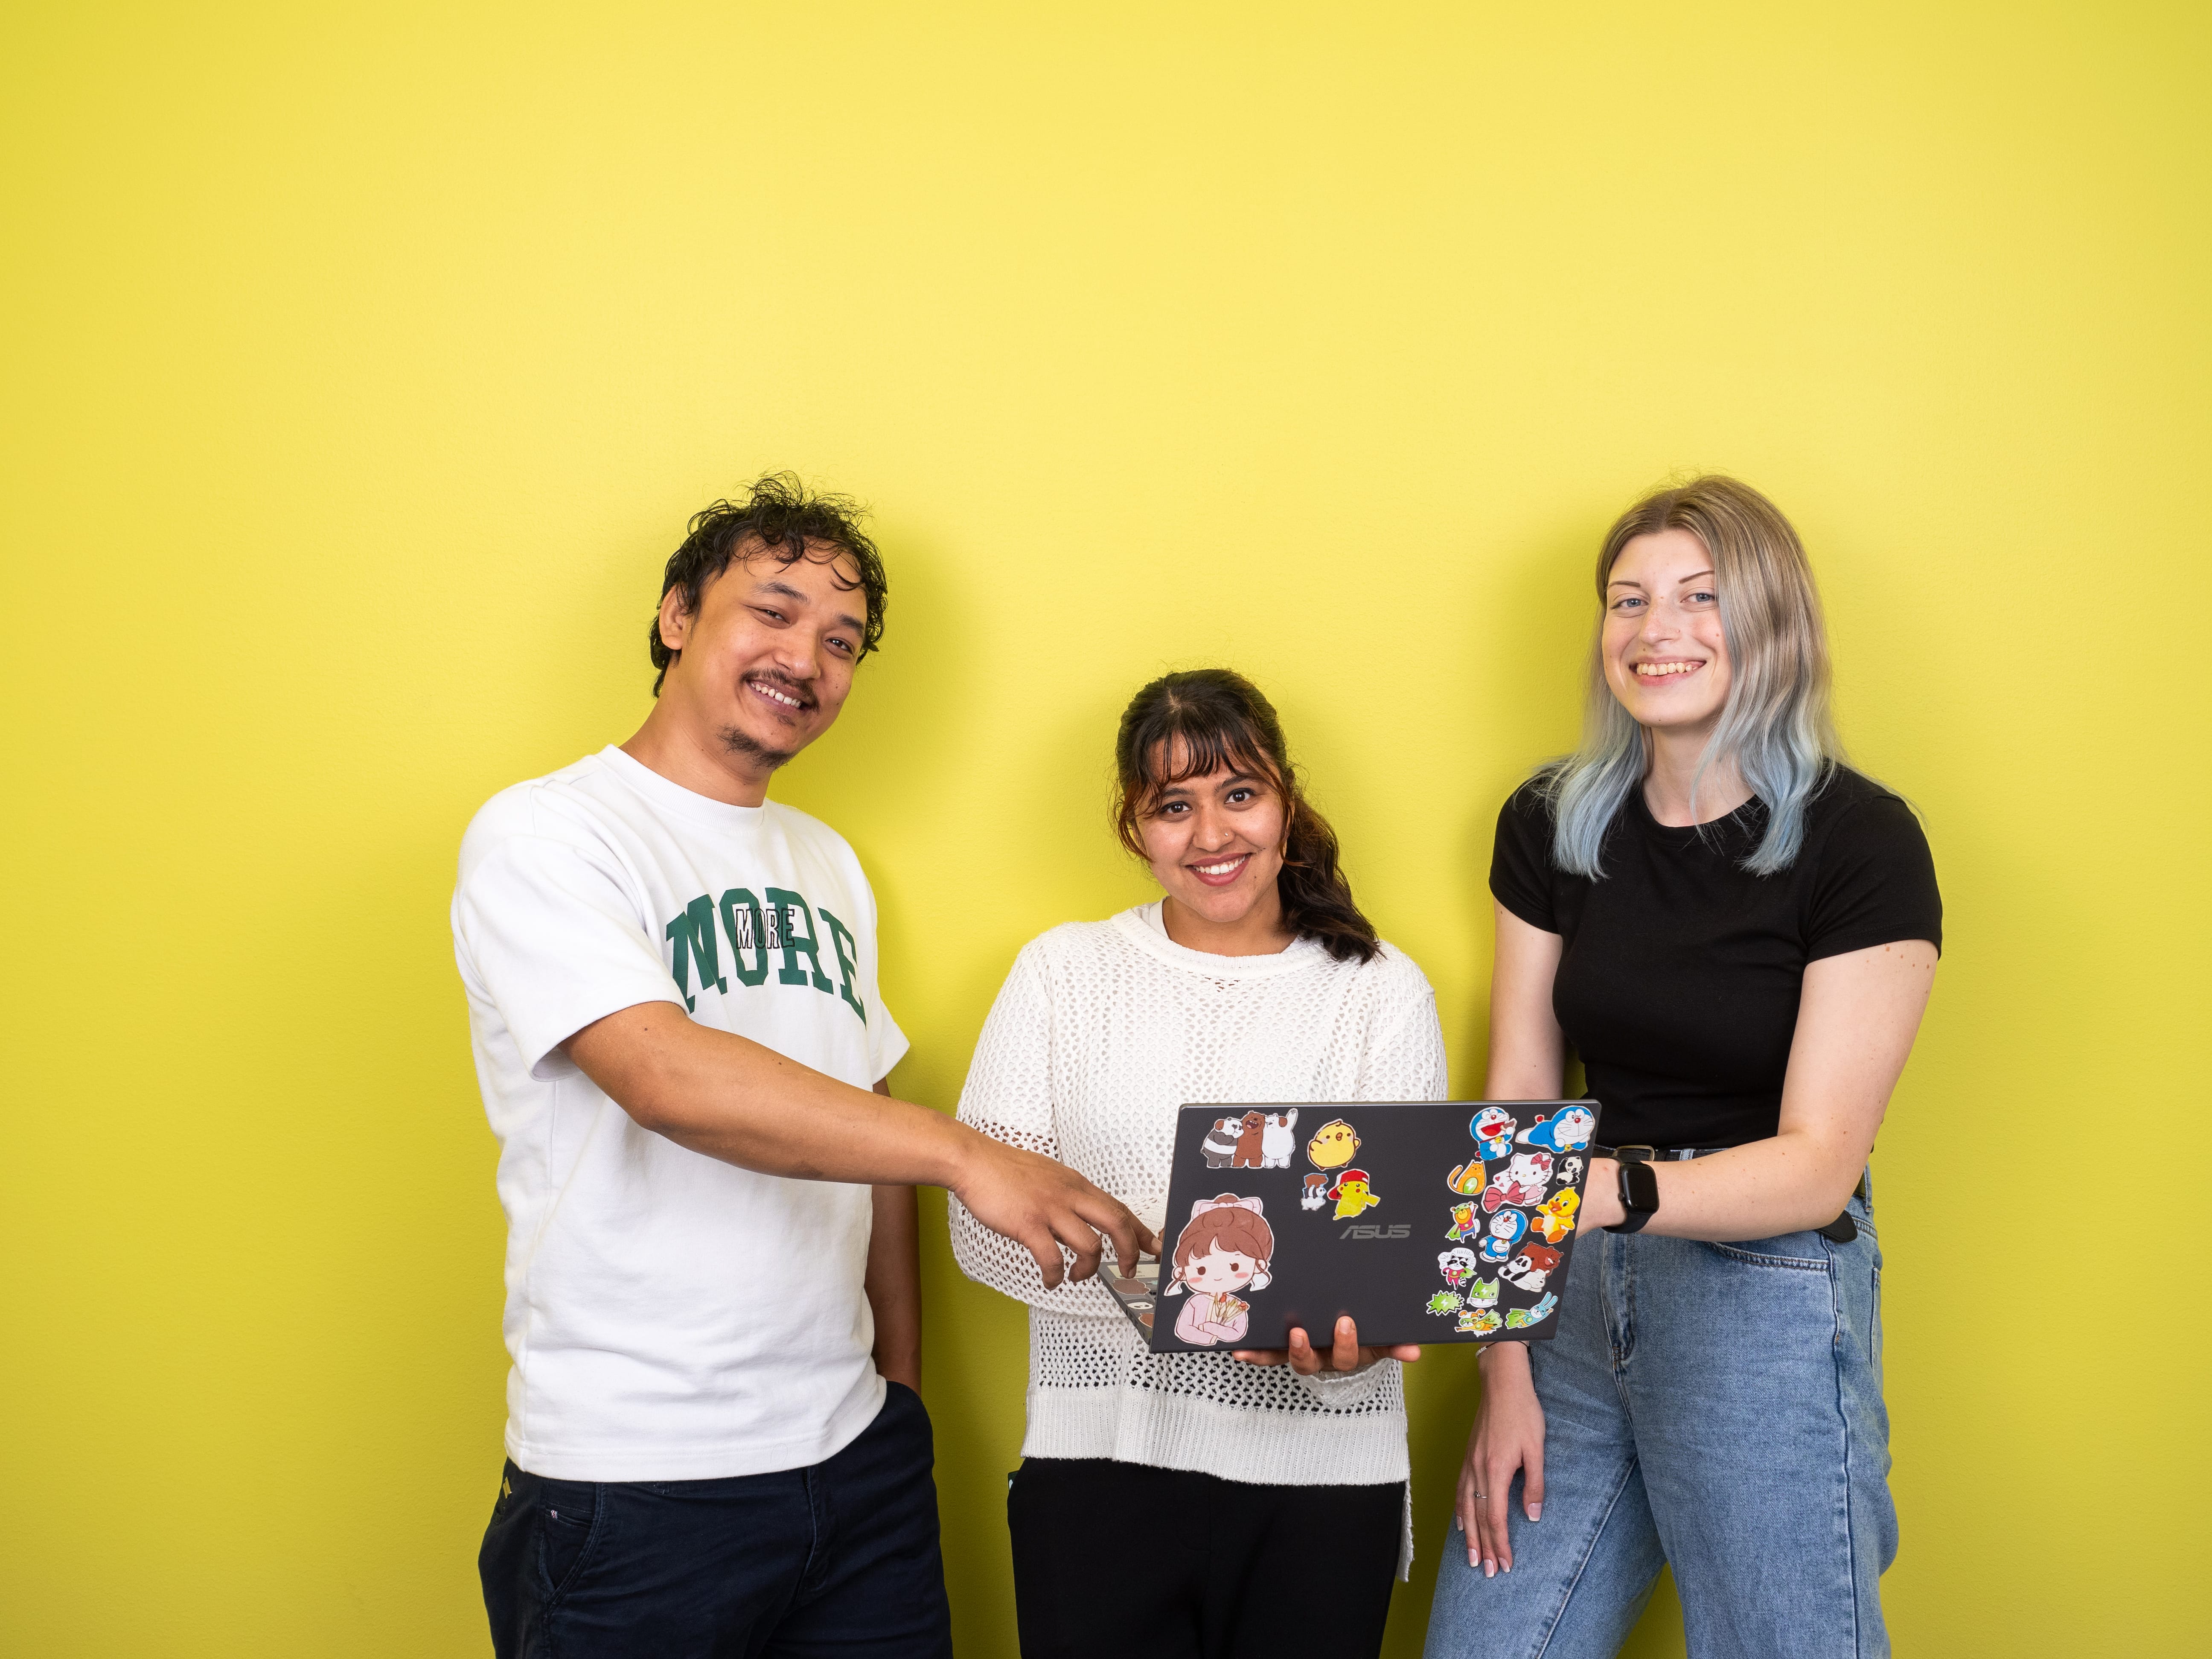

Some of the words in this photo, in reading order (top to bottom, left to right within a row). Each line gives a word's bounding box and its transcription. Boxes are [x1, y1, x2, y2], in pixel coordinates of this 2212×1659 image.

[736, 908, 795, 949] MORE
[666, 887, 867, 1030] MORE
[1339, 1225, 1411, 1239] ASUS
